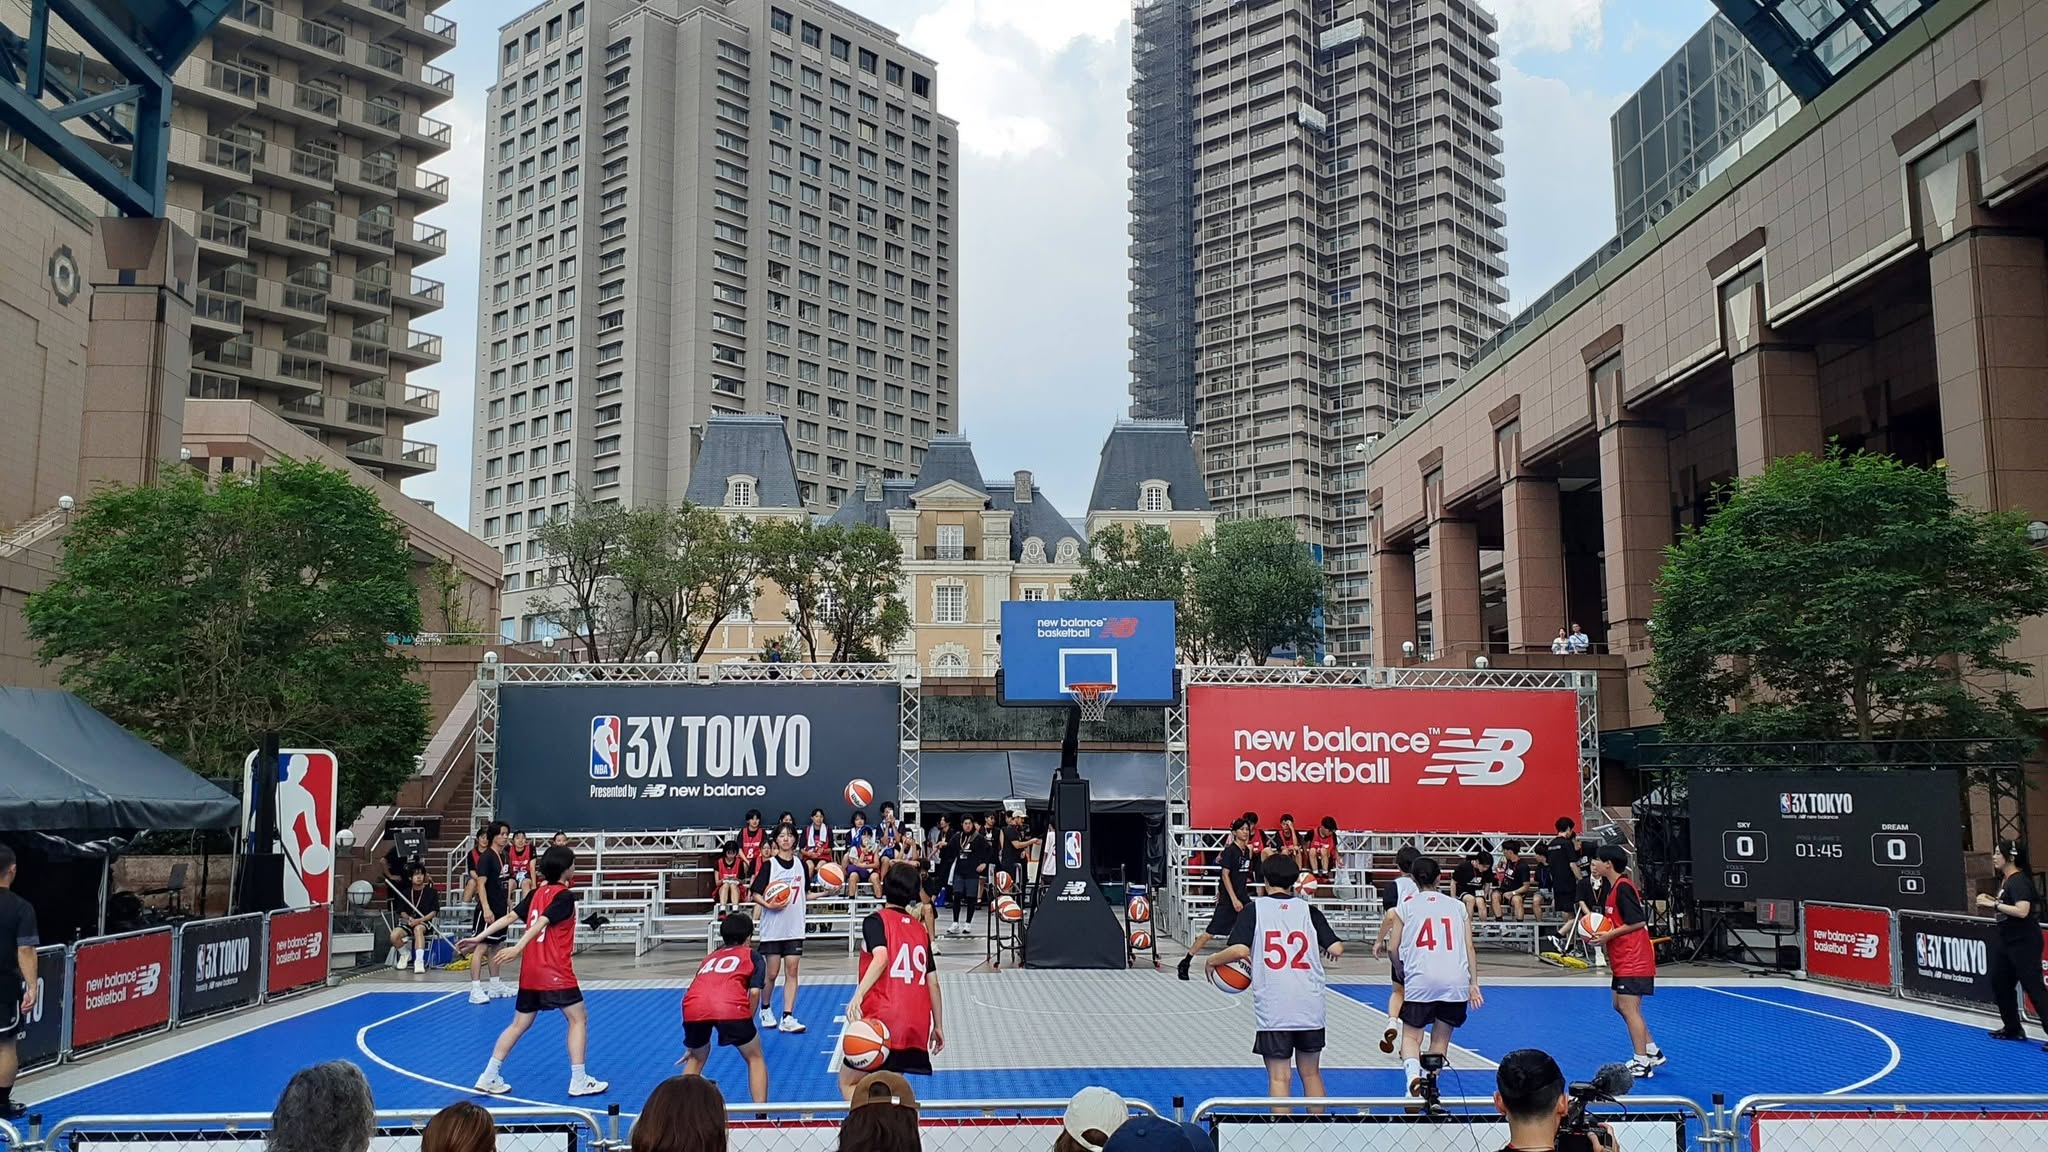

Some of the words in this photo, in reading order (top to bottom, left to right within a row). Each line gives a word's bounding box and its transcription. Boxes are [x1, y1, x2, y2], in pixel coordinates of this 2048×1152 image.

[1037, 618, 1059, 627] new
[1060, 617, 1104, 627] balance
[1037, 628, 1090, 638] basketball
[625, 715, 675, 778] 3X
[681, 714, 811, 778] TOKYO
[1234, 728, 1296, 750] new
[1302, 725, 1430, 753] balance
[594, 764, 608, 775] NBA
[1234, 755, 1390, 784] basketball
[590, 784, 627, 797] Presented
[628, 784, 637, 799] by
[669, 786, 700, 797] new
[703, 783, 766, 797] balance
[1791, 793, 1808, 813] 3X
[1808, 793, 1853, 814] TOKYO
[746, 848, 754, 859] 8
[1736, 836, 1754, 857] 0
[1795, 843, 1843, 858] 01:45
[1887, 839, 1907, 860] 0
[1731, 873, 1741, 884] 0
[1906, 879, 1917, 891] 0
[791, 886, 800, 904] 7
[287, 936, 308, 949] balance
[1415, 917, 1453, 951] 41
[1813, 929, 1828, 939] new
[1827, 929, 1856, 943] balance
[276, 949, 301, 965] basketball
[1263, 931, 1312, 970] 52
[1814, 940, 1848, 955] basketball
[1926, 934, 1944, 969] 3X
[1943, 936, 1988, 976] TOKYO
[204, 942, 218, 980] 3X
[219, 936, 250, 976] TOKYO
[889, 943, 928, 986] 49
[85, 977, 104, 993] new
[104, 969, 137, 988] balance
[85, 986, 127, 1010] basketball
